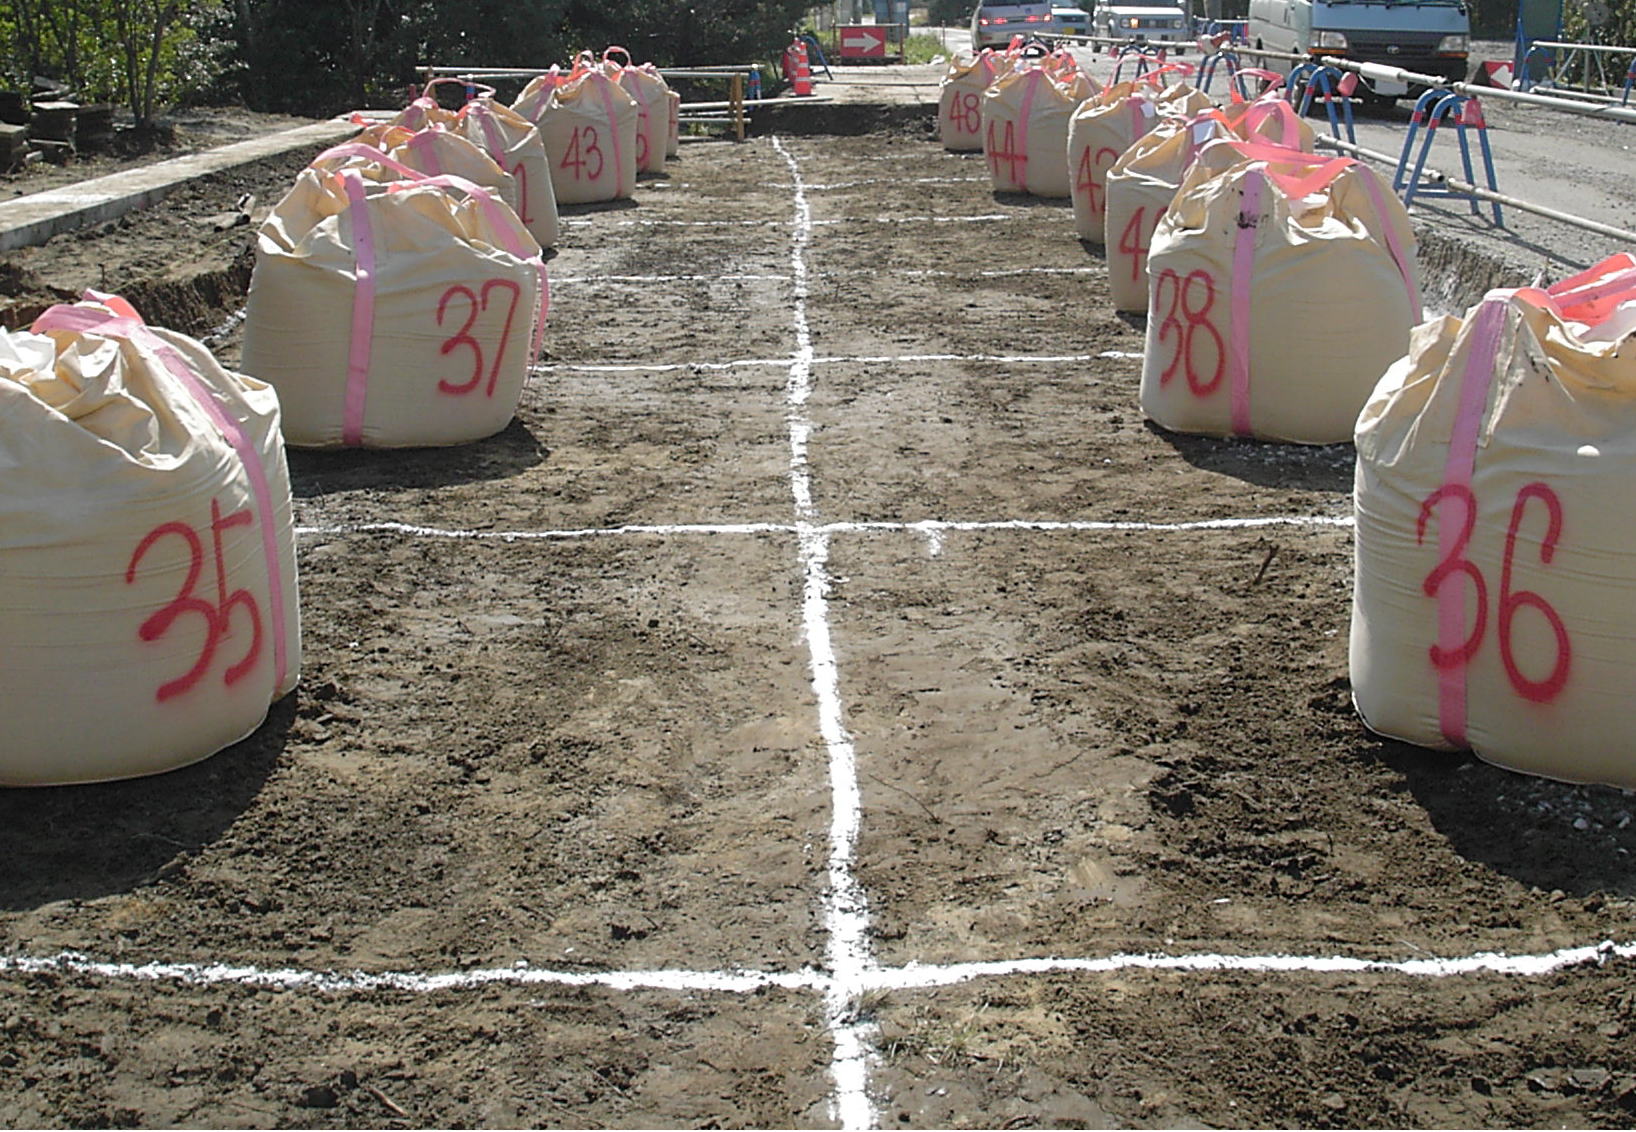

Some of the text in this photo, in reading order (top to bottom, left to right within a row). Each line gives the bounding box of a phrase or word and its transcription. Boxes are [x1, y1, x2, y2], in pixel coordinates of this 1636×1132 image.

[949, 90, 981, 135] 48
[560, 126, 604, 181] 43
[987, 120, 1028, 184] 44
[513, 162, 534, 225] 1
[1119, 205, 1168, 283] 4
[436, 278, 521, 398] 37
[1155, 268, 1226, 397] 38
[125, 497, 265, 704] 35
[1416, 481, 1571, 704] 36
